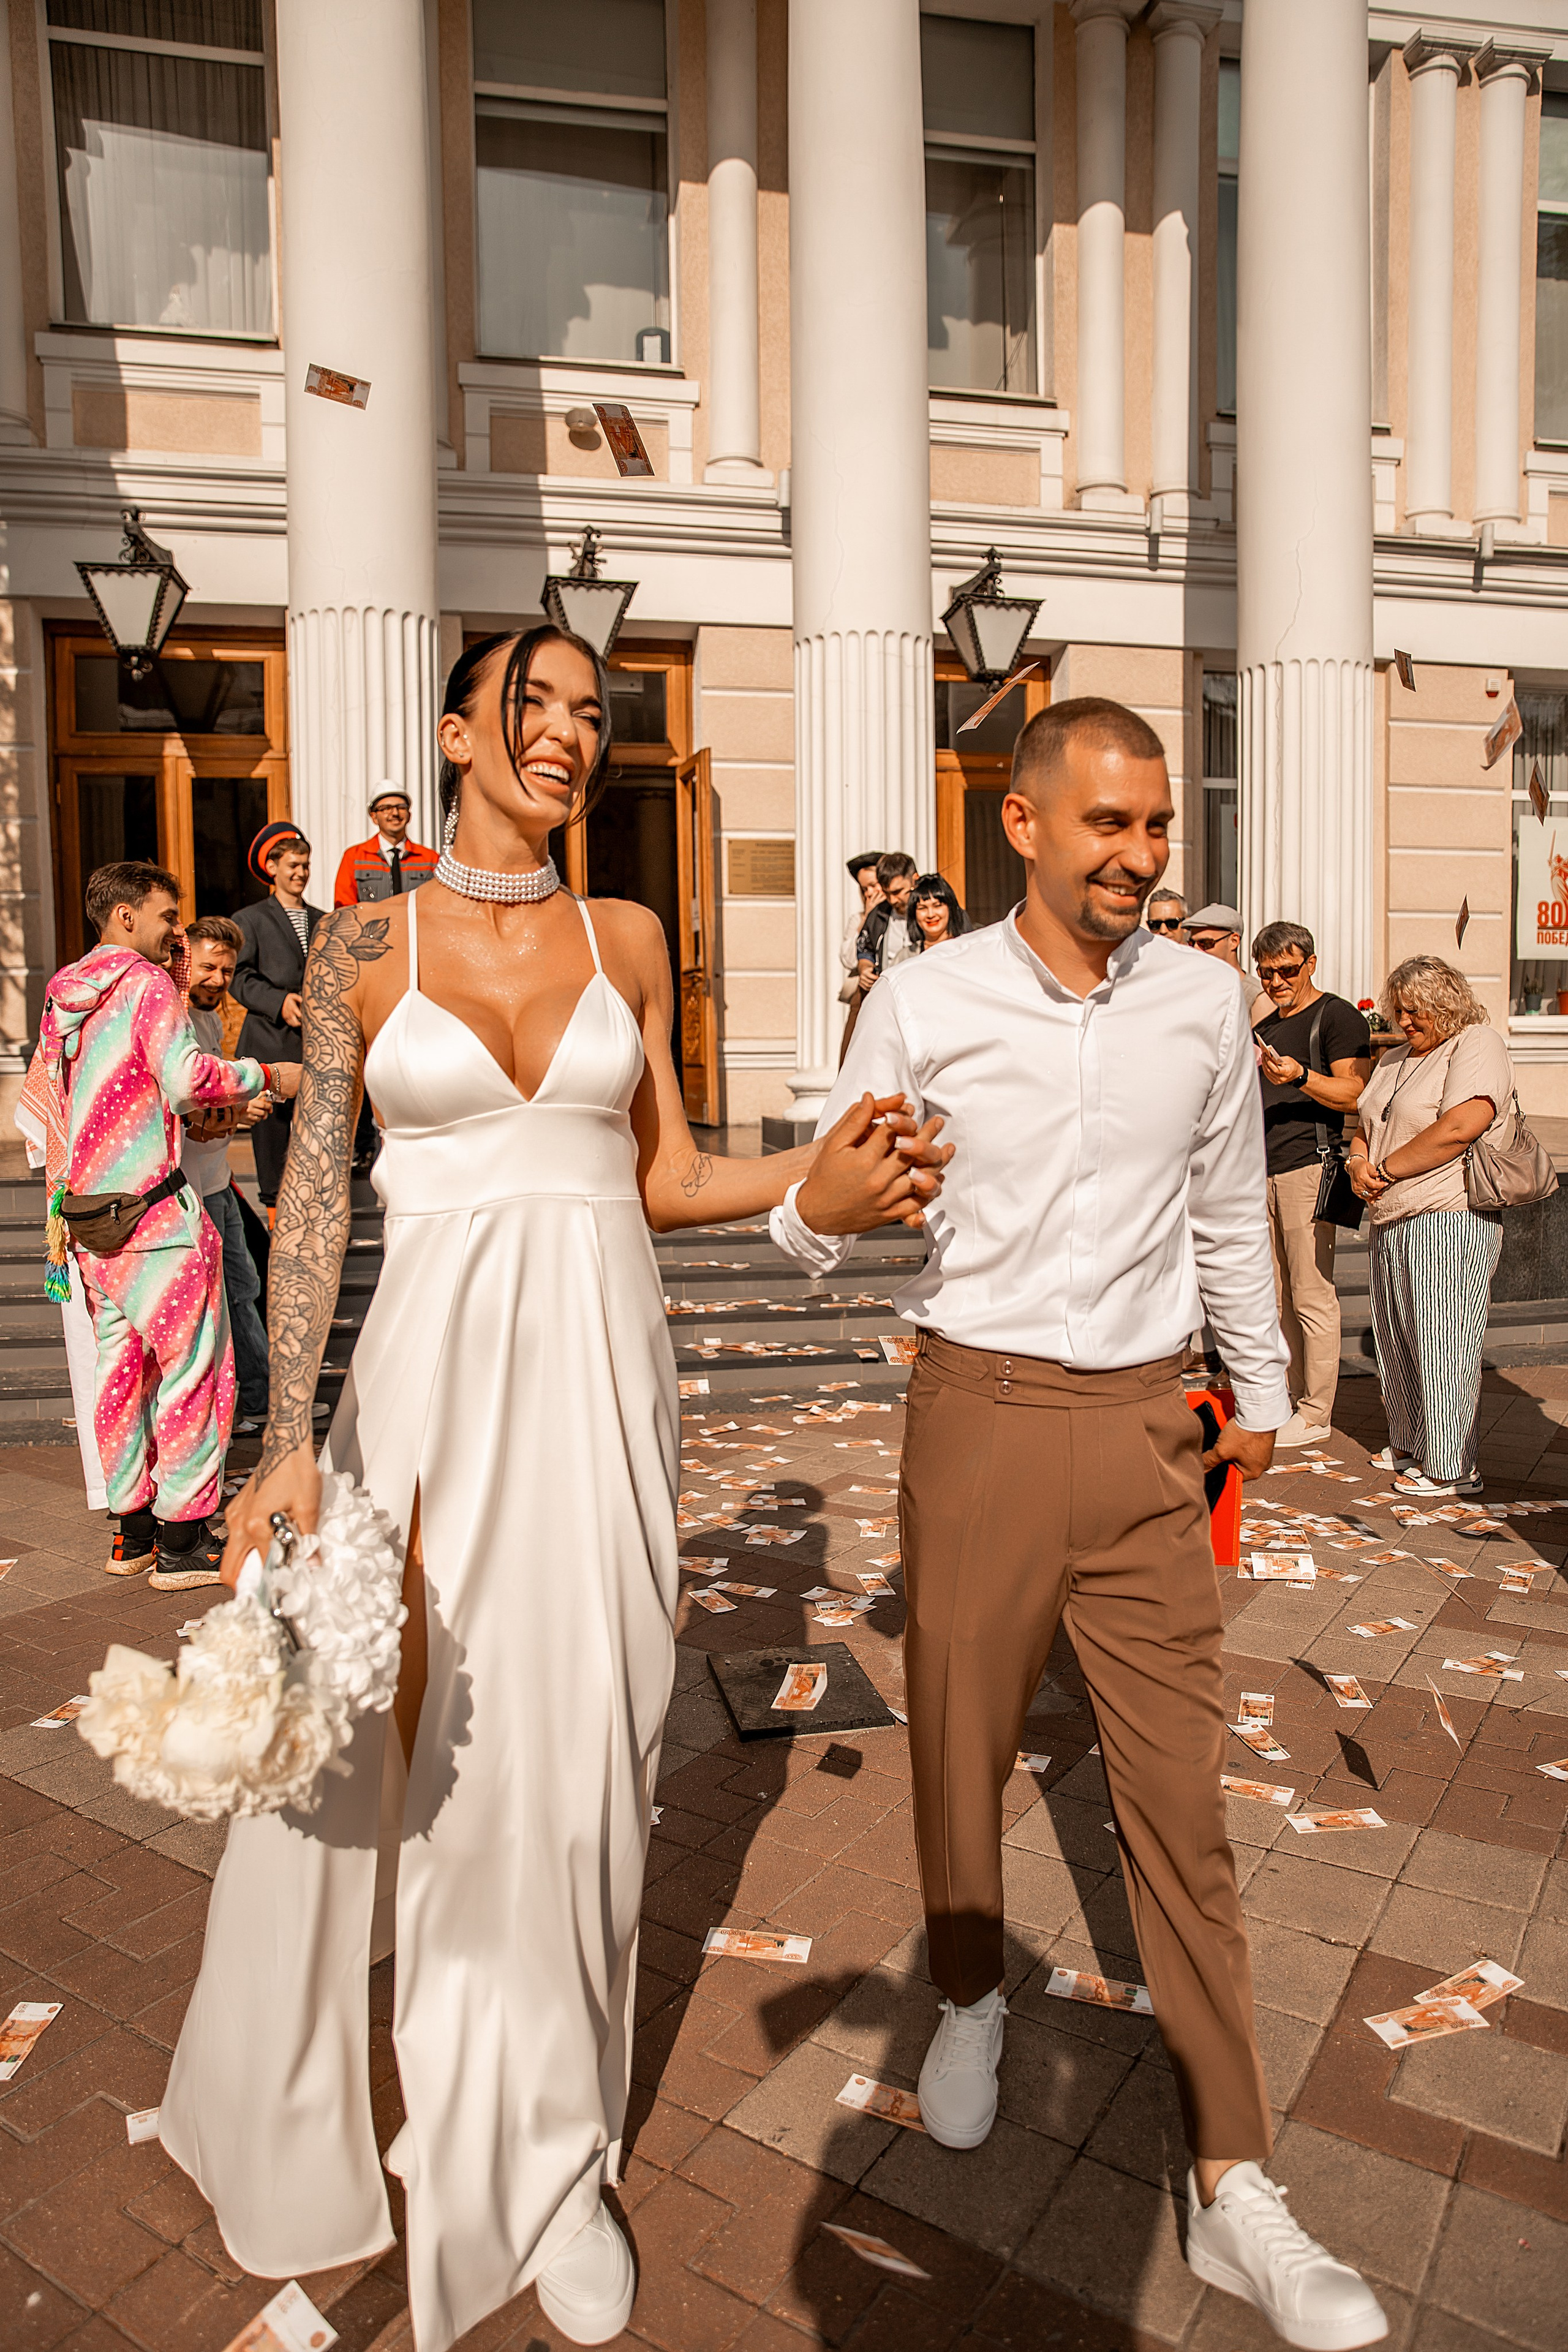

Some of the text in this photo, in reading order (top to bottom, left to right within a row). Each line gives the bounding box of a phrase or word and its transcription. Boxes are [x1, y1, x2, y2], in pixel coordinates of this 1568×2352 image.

[1537, 901, 1562, 926] 80
[1426, 1986, 1448, 1999] 5000
[1449, 2018, 1476, 2029] 5000
